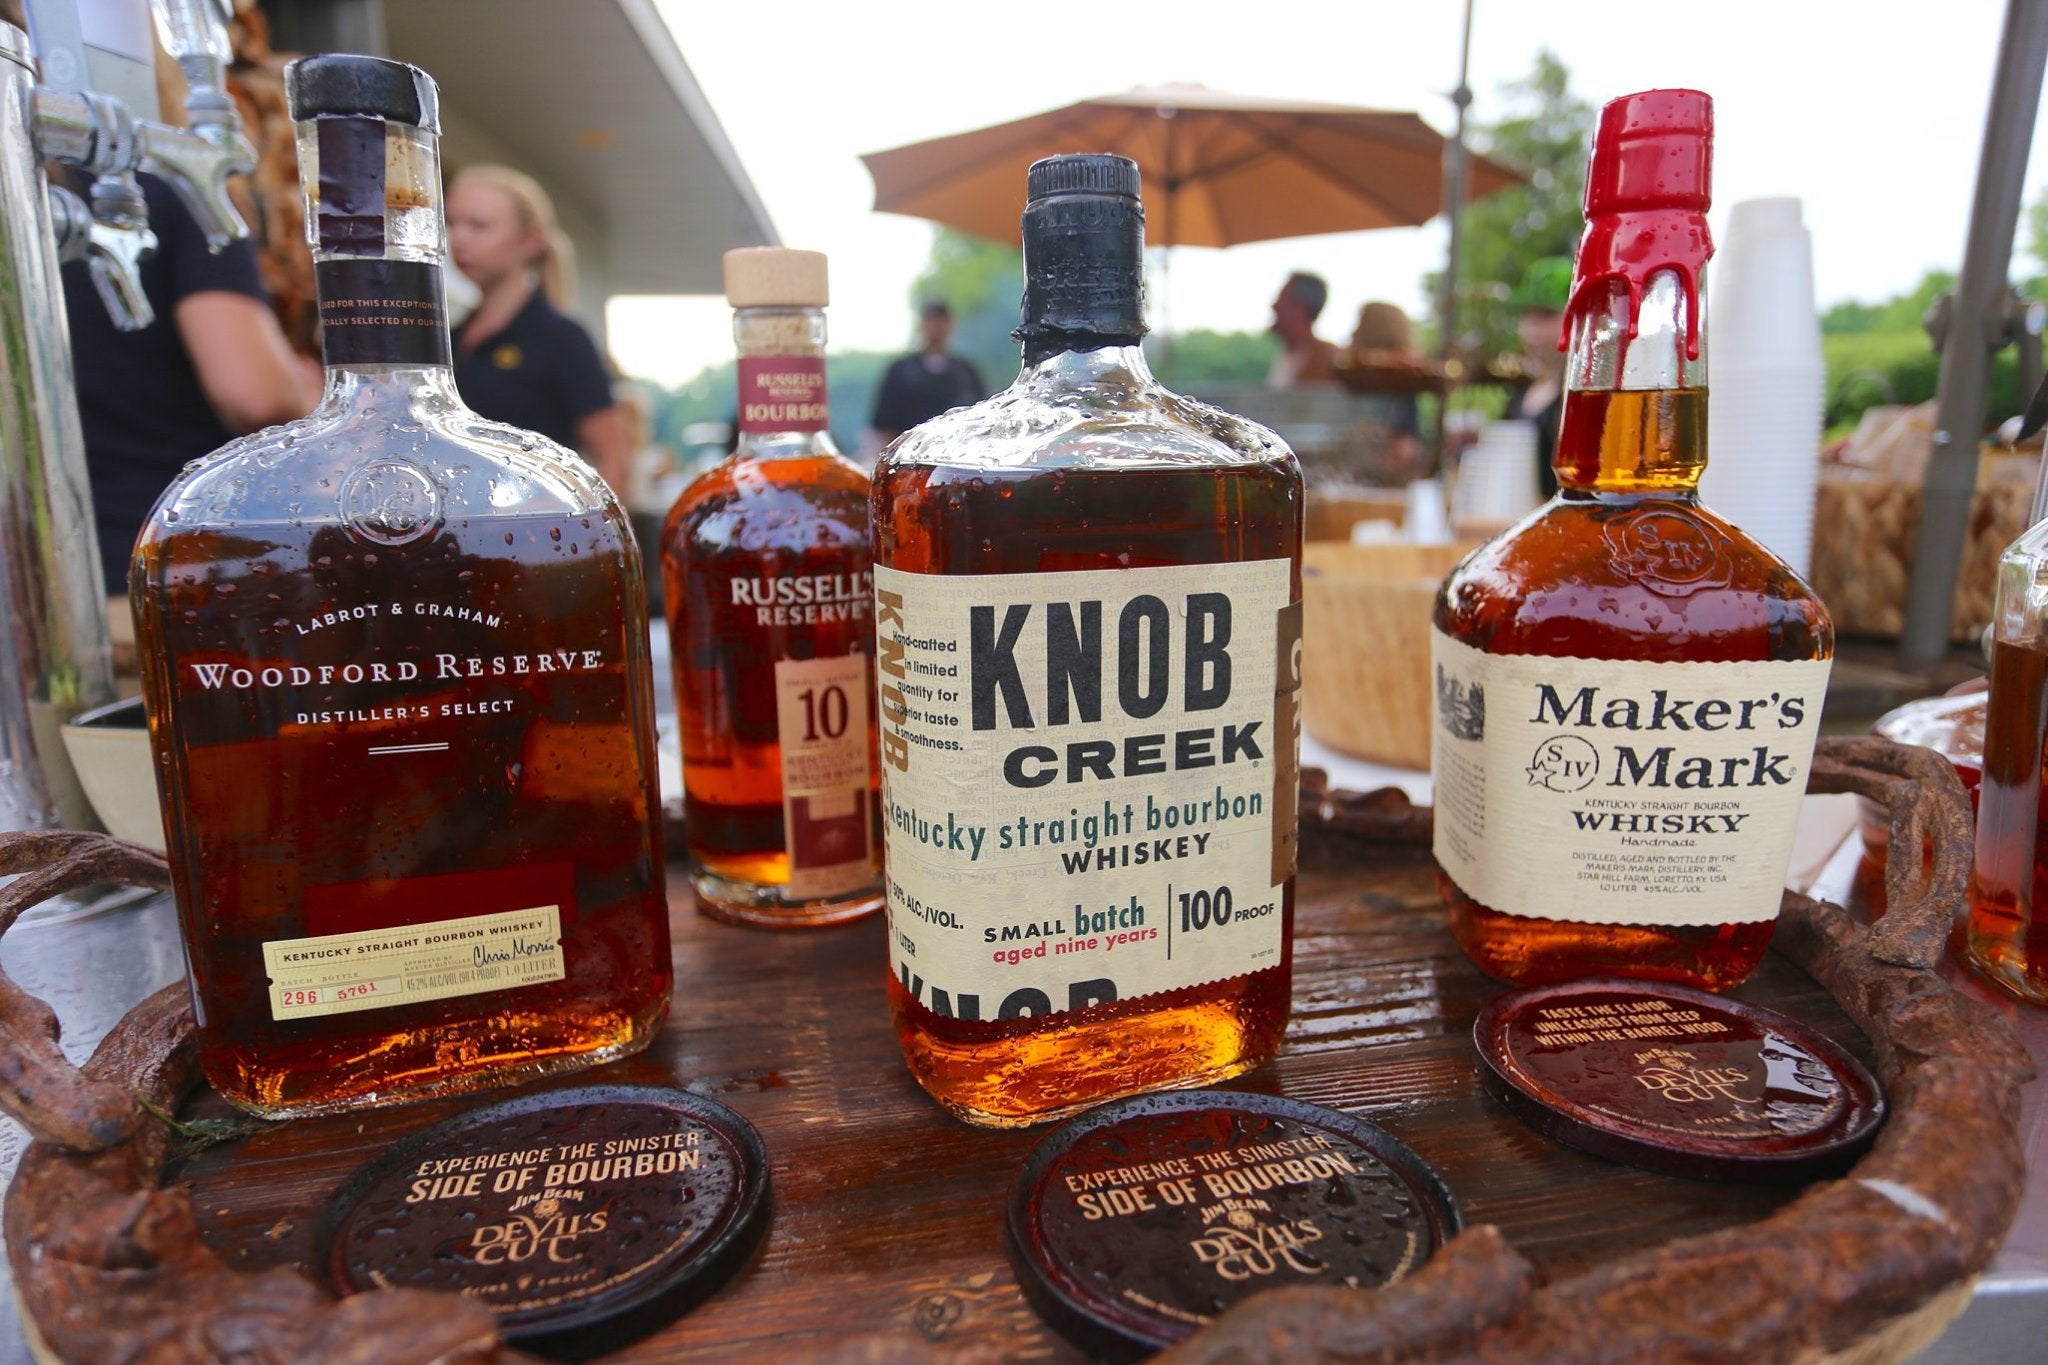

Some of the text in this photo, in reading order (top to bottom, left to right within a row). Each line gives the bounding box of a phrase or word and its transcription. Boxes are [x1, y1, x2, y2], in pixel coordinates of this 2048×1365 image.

[337, 300, 354, 308] FOR
[356, 299, 380, 307] THIS
[351, 317, 400, 325] SELECTED
[402, 317, 415, 326] BY
[296, 602, 501, 636] LABROT & GRAHAM
[756, 601, 863, 627] RESERVE
[892, 631, 957, 652] Hand-crafted
[191, 649, 598, 690] WOODFORD RESERVE
[904, 658, 958, 677] in limited
[970, 592, 1233, 732] KNOB
[878, 588, 909, 773] KNOB
[897, 681, 959, 702] quantity for
[297, 700, 514, 725] DISTILLER'S SELECT
[798, 685, 848, 742] 10
[893, 702, 959, 726] superior taste
[1529, 683, 1805, 731] Maker's
[900, 728, 963, 751] smoothness.
[1003, 721, 1264, 789] CREEK
[1606, 745, 1793, 789] Mark
[1585, 798, 1740, 811] KENTUCKY STRAIGHT BOURBON
[889, 785, 1262, 862] kentucky straight bourbon
[1571, 810, 1750, 834] WHISKY
[1621, 836, 1696, 847] Handmade
[1061, 833, 1212, 876] WHISKEY
[1620, 854, 1645, 863] AGED
[1646, 855, 1666, 863] AND
[1667, 855, 1707, 864] BOTTLED
[1708, 855, 1720, 863] BY
[1721, 854, 1737, 862] THE
[1577, 871, 1600, 881] STAR
[1602, 873, 1622, 882] HILL
[1710, 875, 1727, 883] USA
[1585, 863, 1626, 872] MAKER'S
[1628, 865, 1655, 873] MARK
[1612, 884, 1637, 893] LITER
[906, 894, 964, 930] ALC./VOL.
[984, 886, 1276, 943] SMALL batch 100 PROOF
[283, 920, 544, 963] KENTUCKY STRAIGHT BOURBON WHISKEY
[899, 930, 916, 958] LITER
[993, 927, 1158, 966] aged nine years
[473, 944, 511, 969] Chris
[522, 957, 557, 975] LITER
[283, 982, 377, 1006] 296 5761
[1535, 1010, 1701, 1033] UNLEASHED FROM DEEP
[1540, 1000, 1672, 1020] TASTE THE FLAVOR
[1535, 1021, 1733, 1046] WITHIN THE BARREL WOOD.
[1633, 1066, 1749, 1090] DEVIL'S
[1663, 1083, 1757, 1103] CUT
[416, 1132, 700, 1177] EXPERIENCE THE SINISTER
[1065, 1135, 1333, 1193] EXPERIENCE THE SINISTER
[406, 1149, 708, 1203] SIDE OF BOURBON.
[1076, 1151, 1365, 1221] SIDE OF BOURBON.
[543, 1188, 585, 1202] BEAM
[1200, 1203, 1226, 1225] JIM
[470, 1211, 608, 1247] DEVIL'S
[1190, 1219, 1323, 1262] DEVIL'S
[474, 1236, 584, 1266] CUT
[1215, 1245, 1322, 1281] CUT
